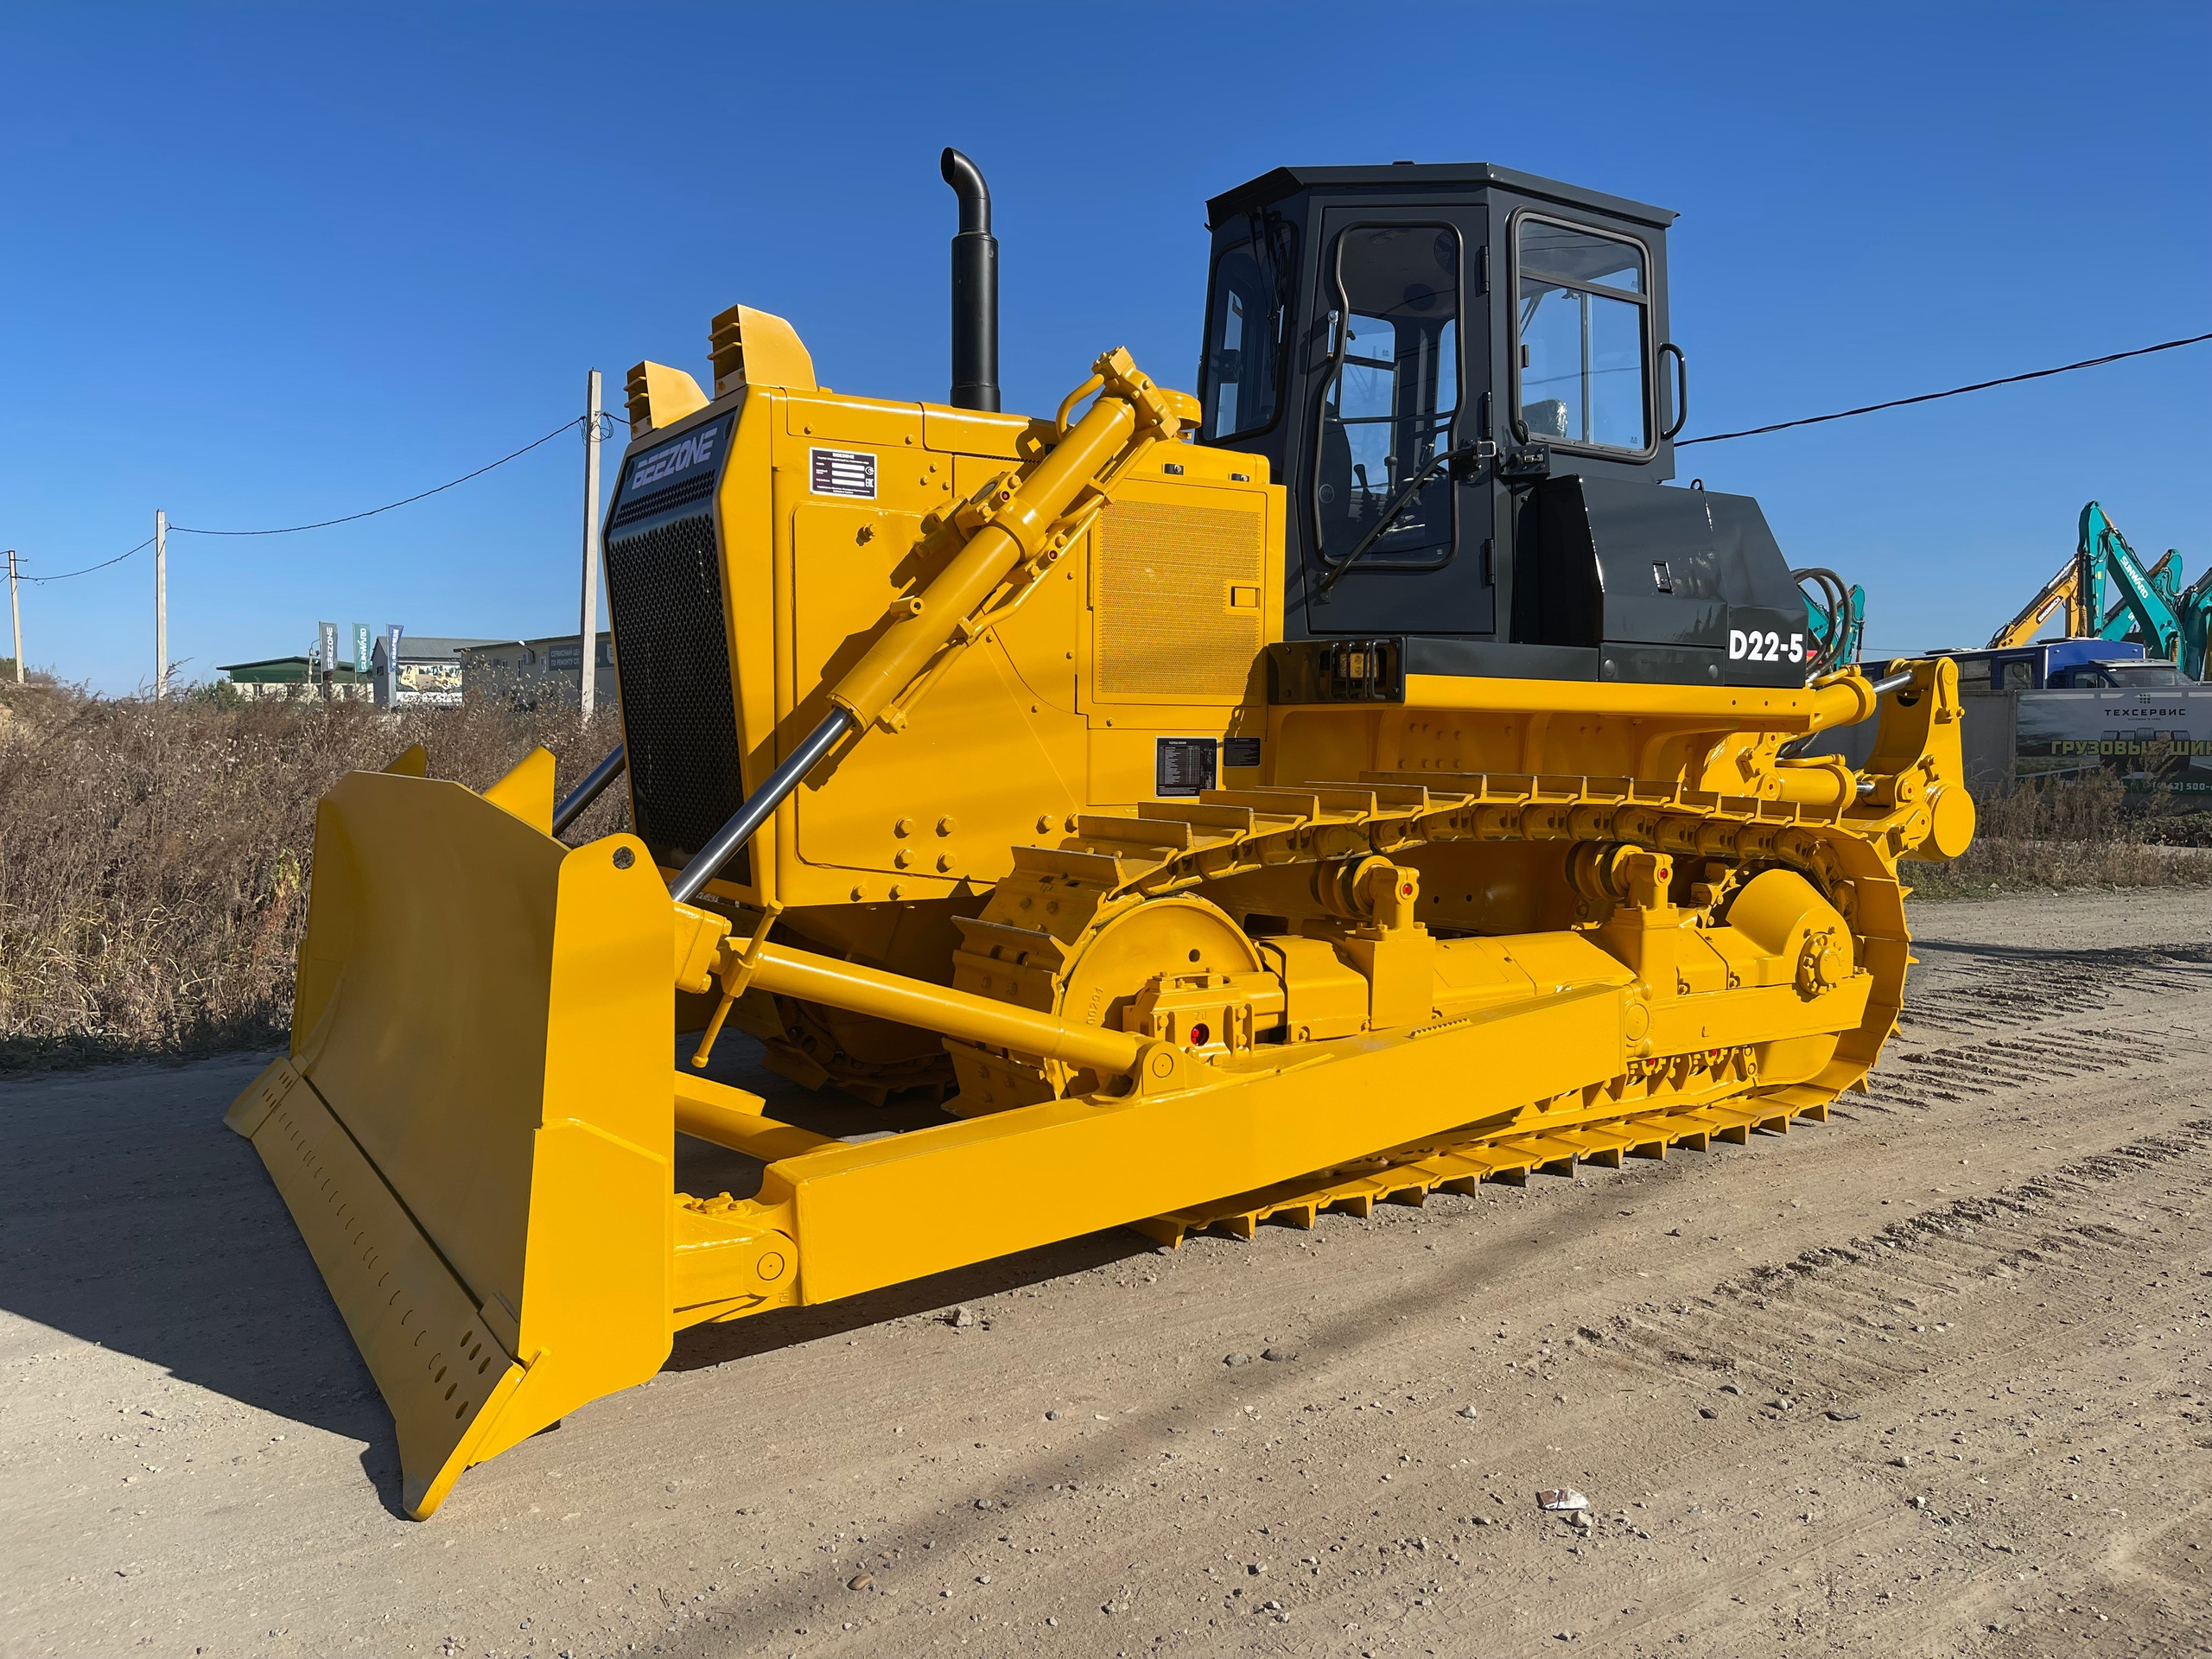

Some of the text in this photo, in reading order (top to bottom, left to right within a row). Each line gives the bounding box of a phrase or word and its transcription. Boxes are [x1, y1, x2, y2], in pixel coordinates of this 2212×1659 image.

[632, 427, 717, 490] BEEZONE
[2120, 555, 2149, 599] SUNWARD
[357, 627, 367, 671] SUNWARD
[1729, 629, 1803, 664] D22-5
[2050, 741, 2158, 756] ГРУЗОВЫ
